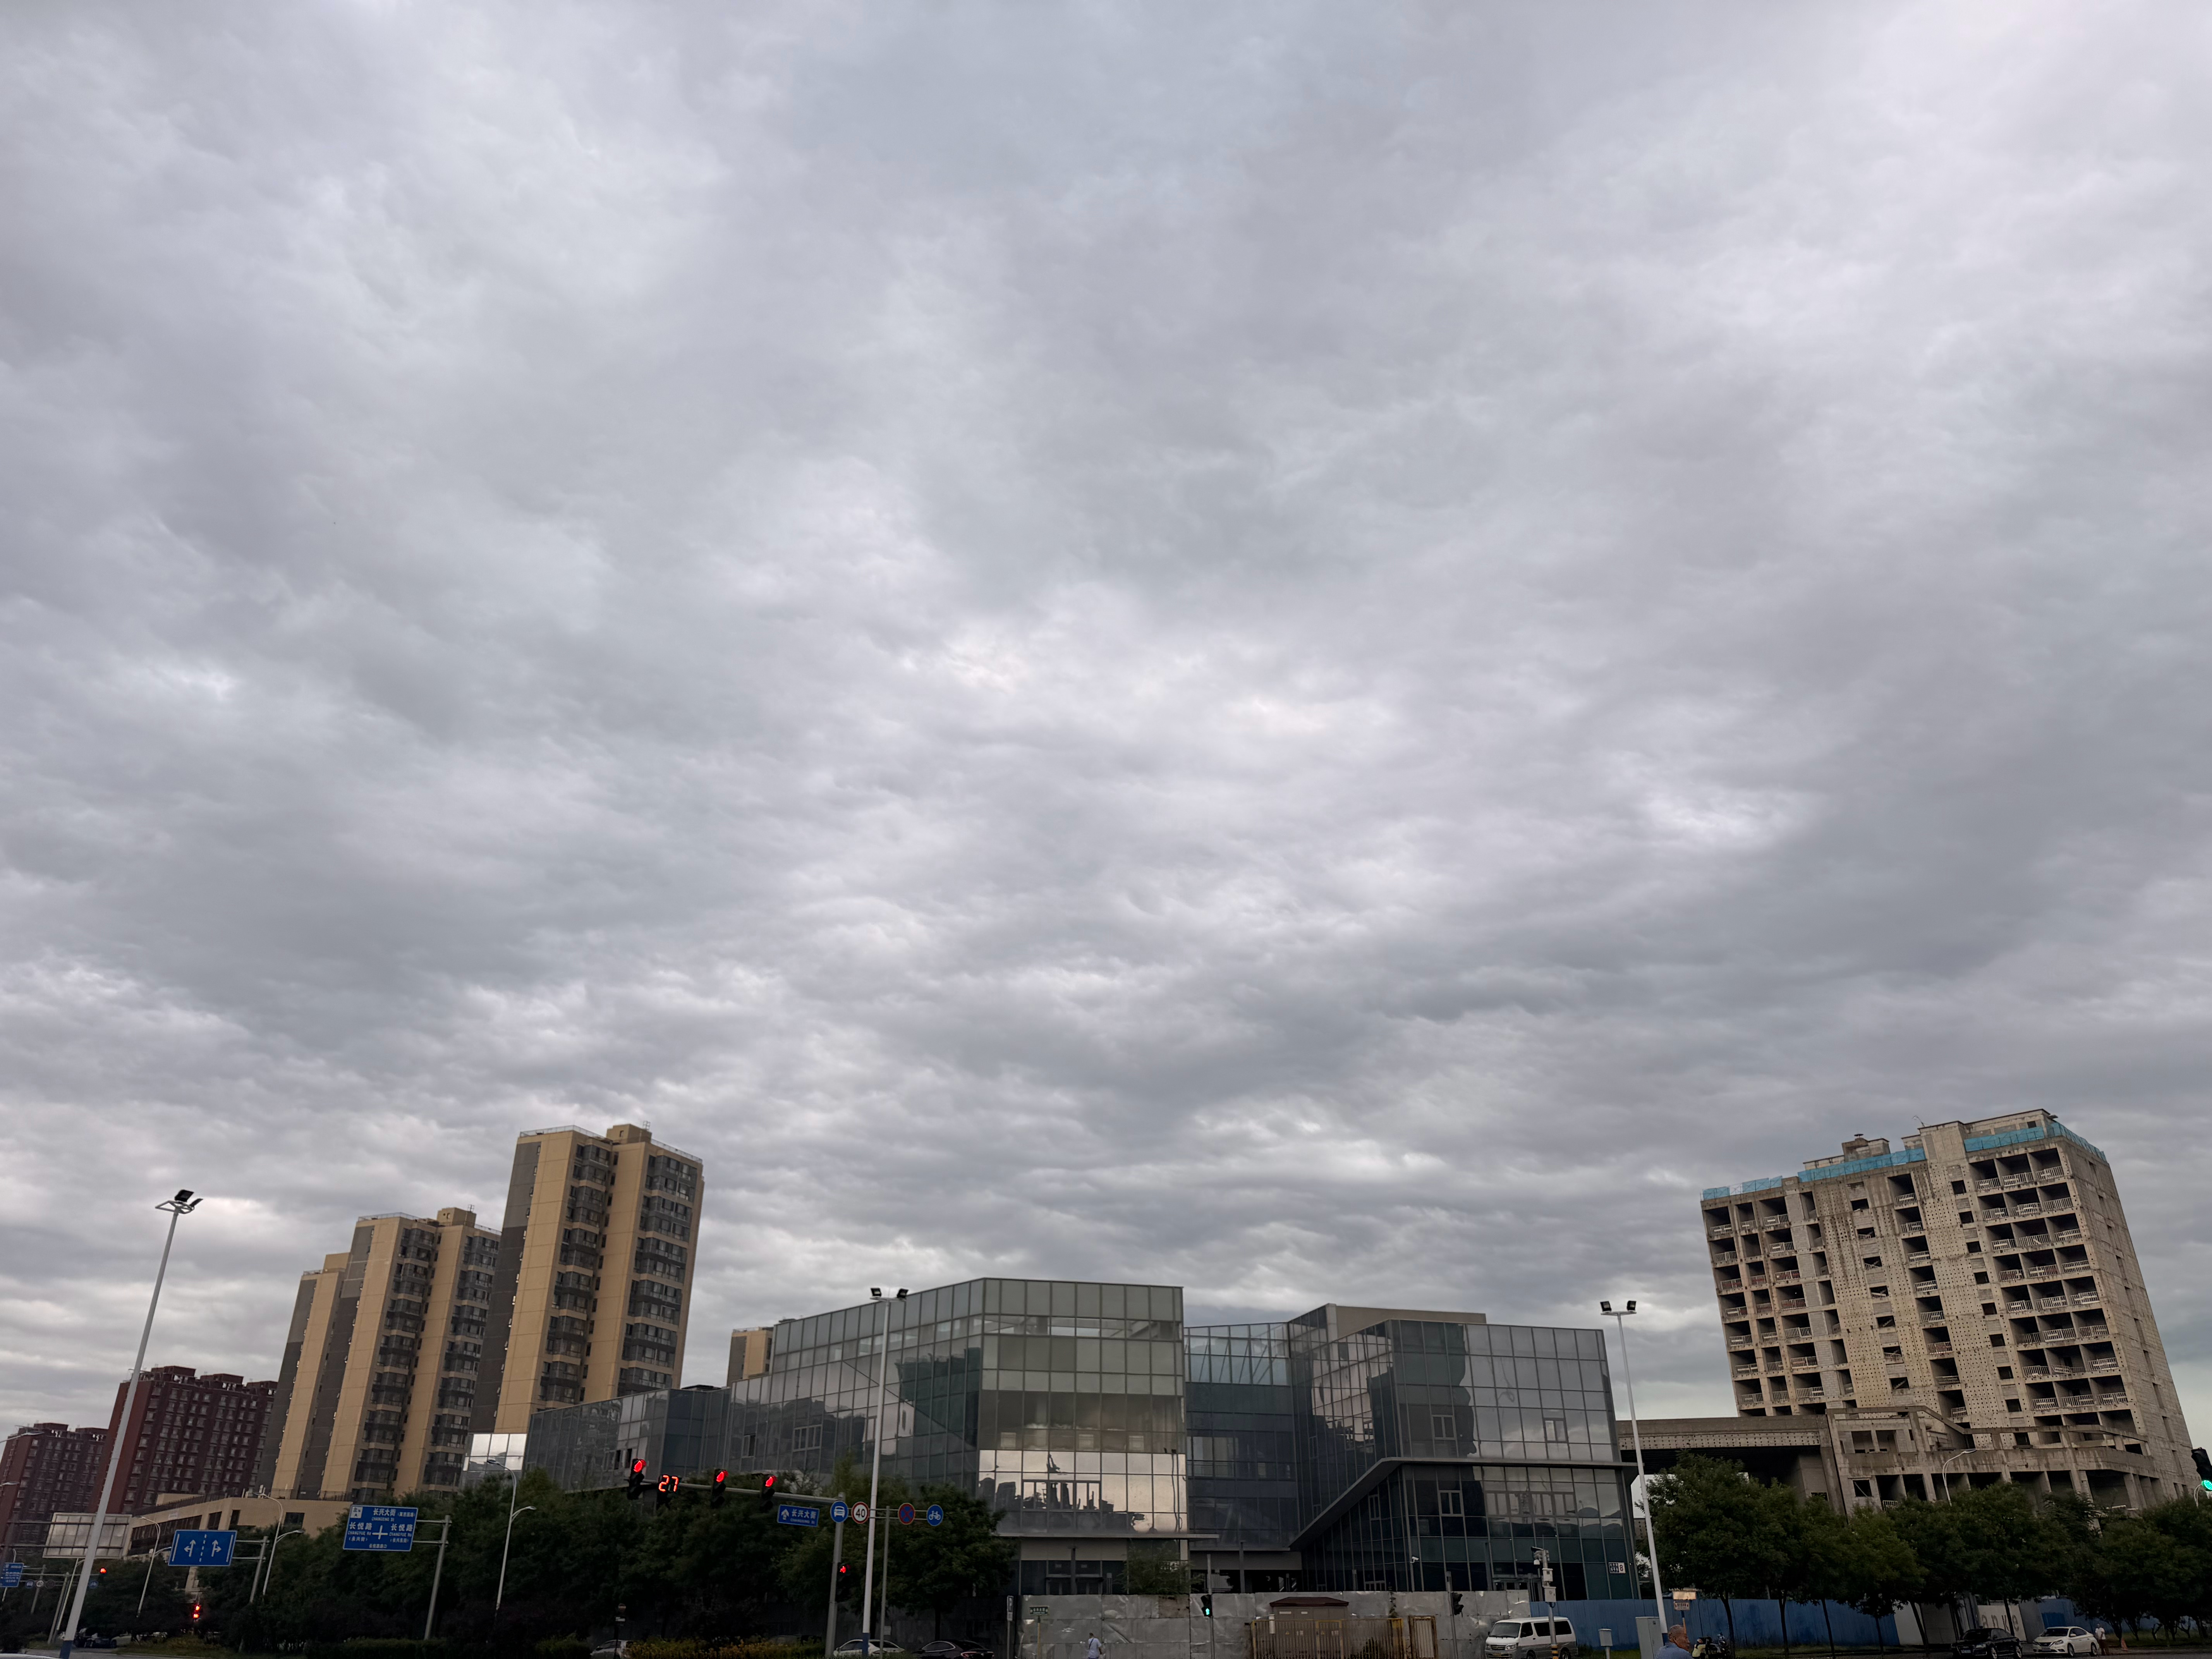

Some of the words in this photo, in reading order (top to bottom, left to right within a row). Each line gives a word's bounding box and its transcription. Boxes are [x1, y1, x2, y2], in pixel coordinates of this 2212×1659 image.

[658, 1475, 679, 1492] 27
[373, 1508, 396, 1516] 长兴大街
[792, 1508, 817, 1519] 长兴大街
[856, 1509, 866, 1518] 40
